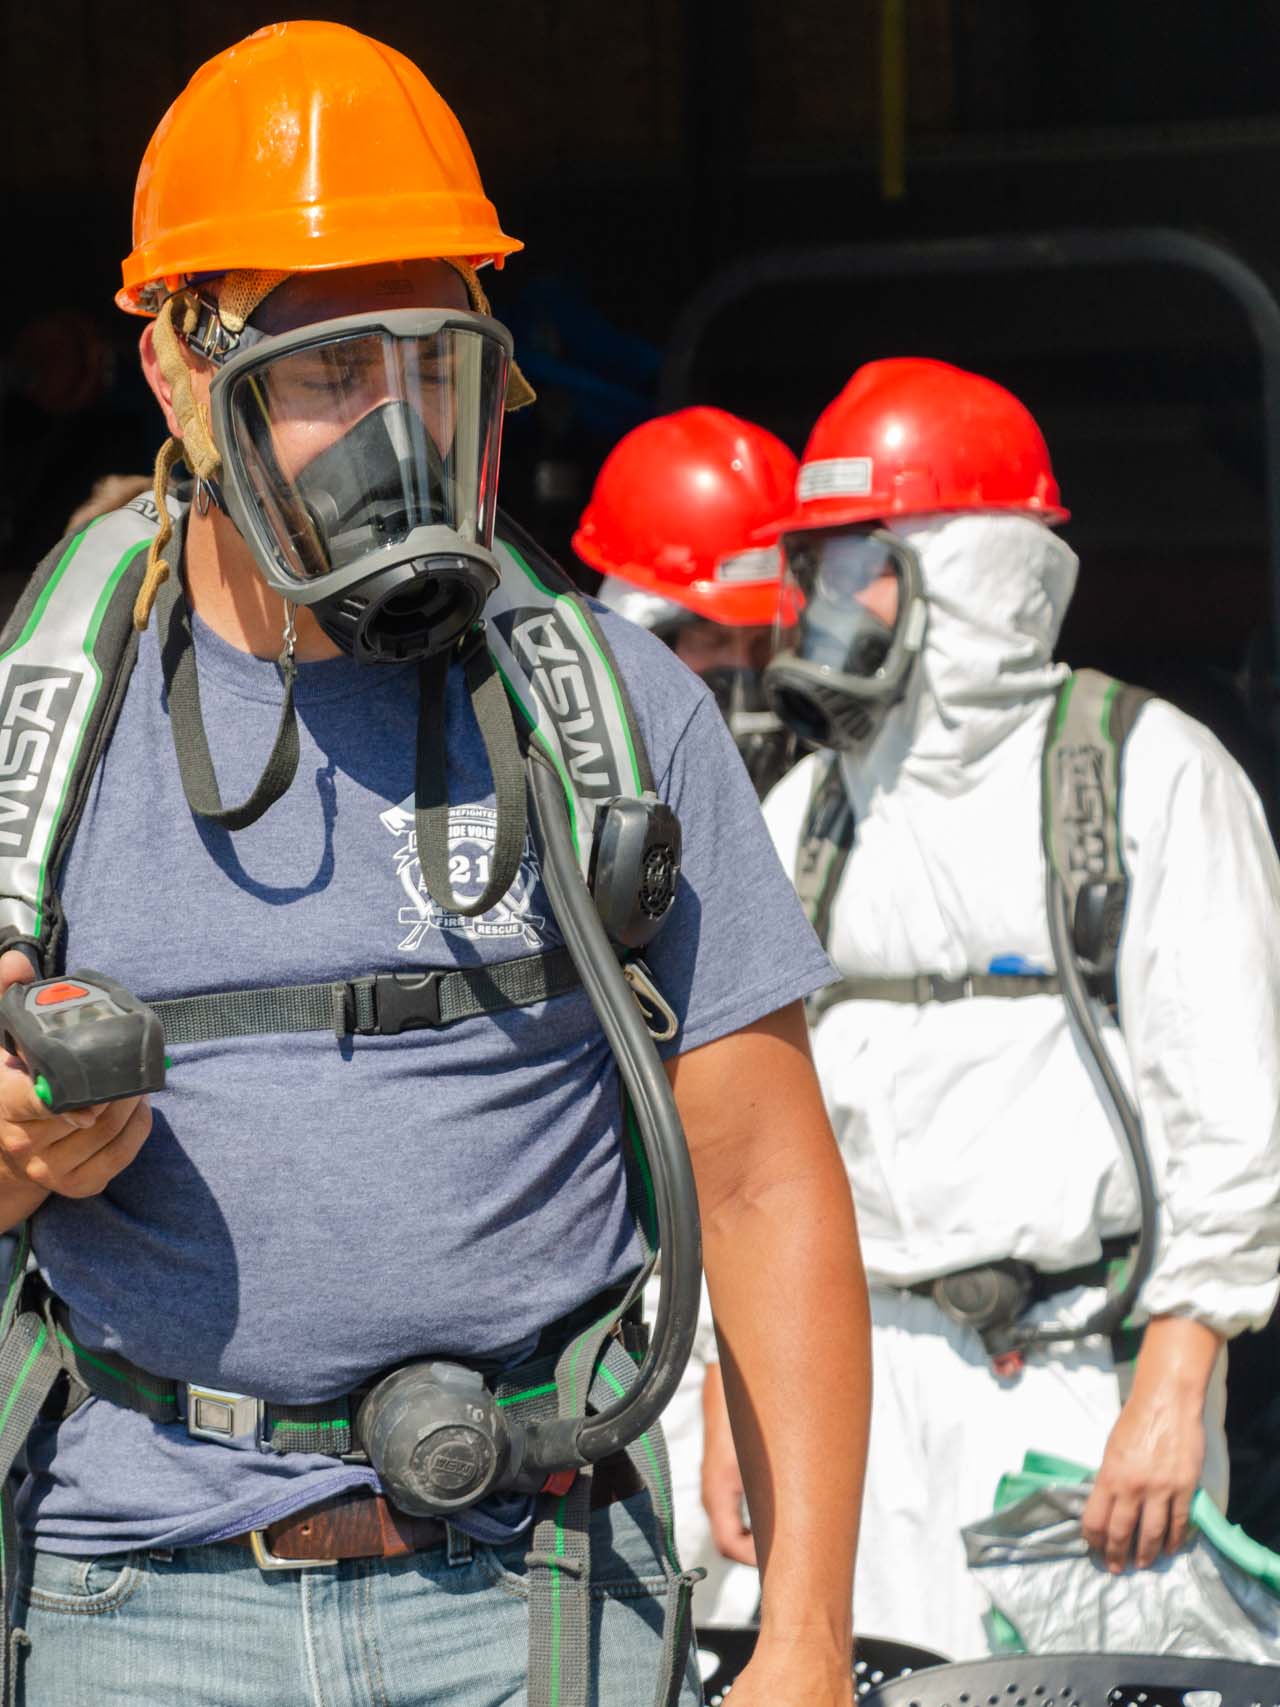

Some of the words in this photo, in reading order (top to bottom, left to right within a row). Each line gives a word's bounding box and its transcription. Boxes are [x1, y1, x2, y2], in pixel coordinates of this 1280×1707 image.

[511, 613, 610, 786] MSA
[449, 809, 497, 819] REFIGHTE
[449, 855, 490, 884] 21
[477, 923, 519, 934] RESCUE
